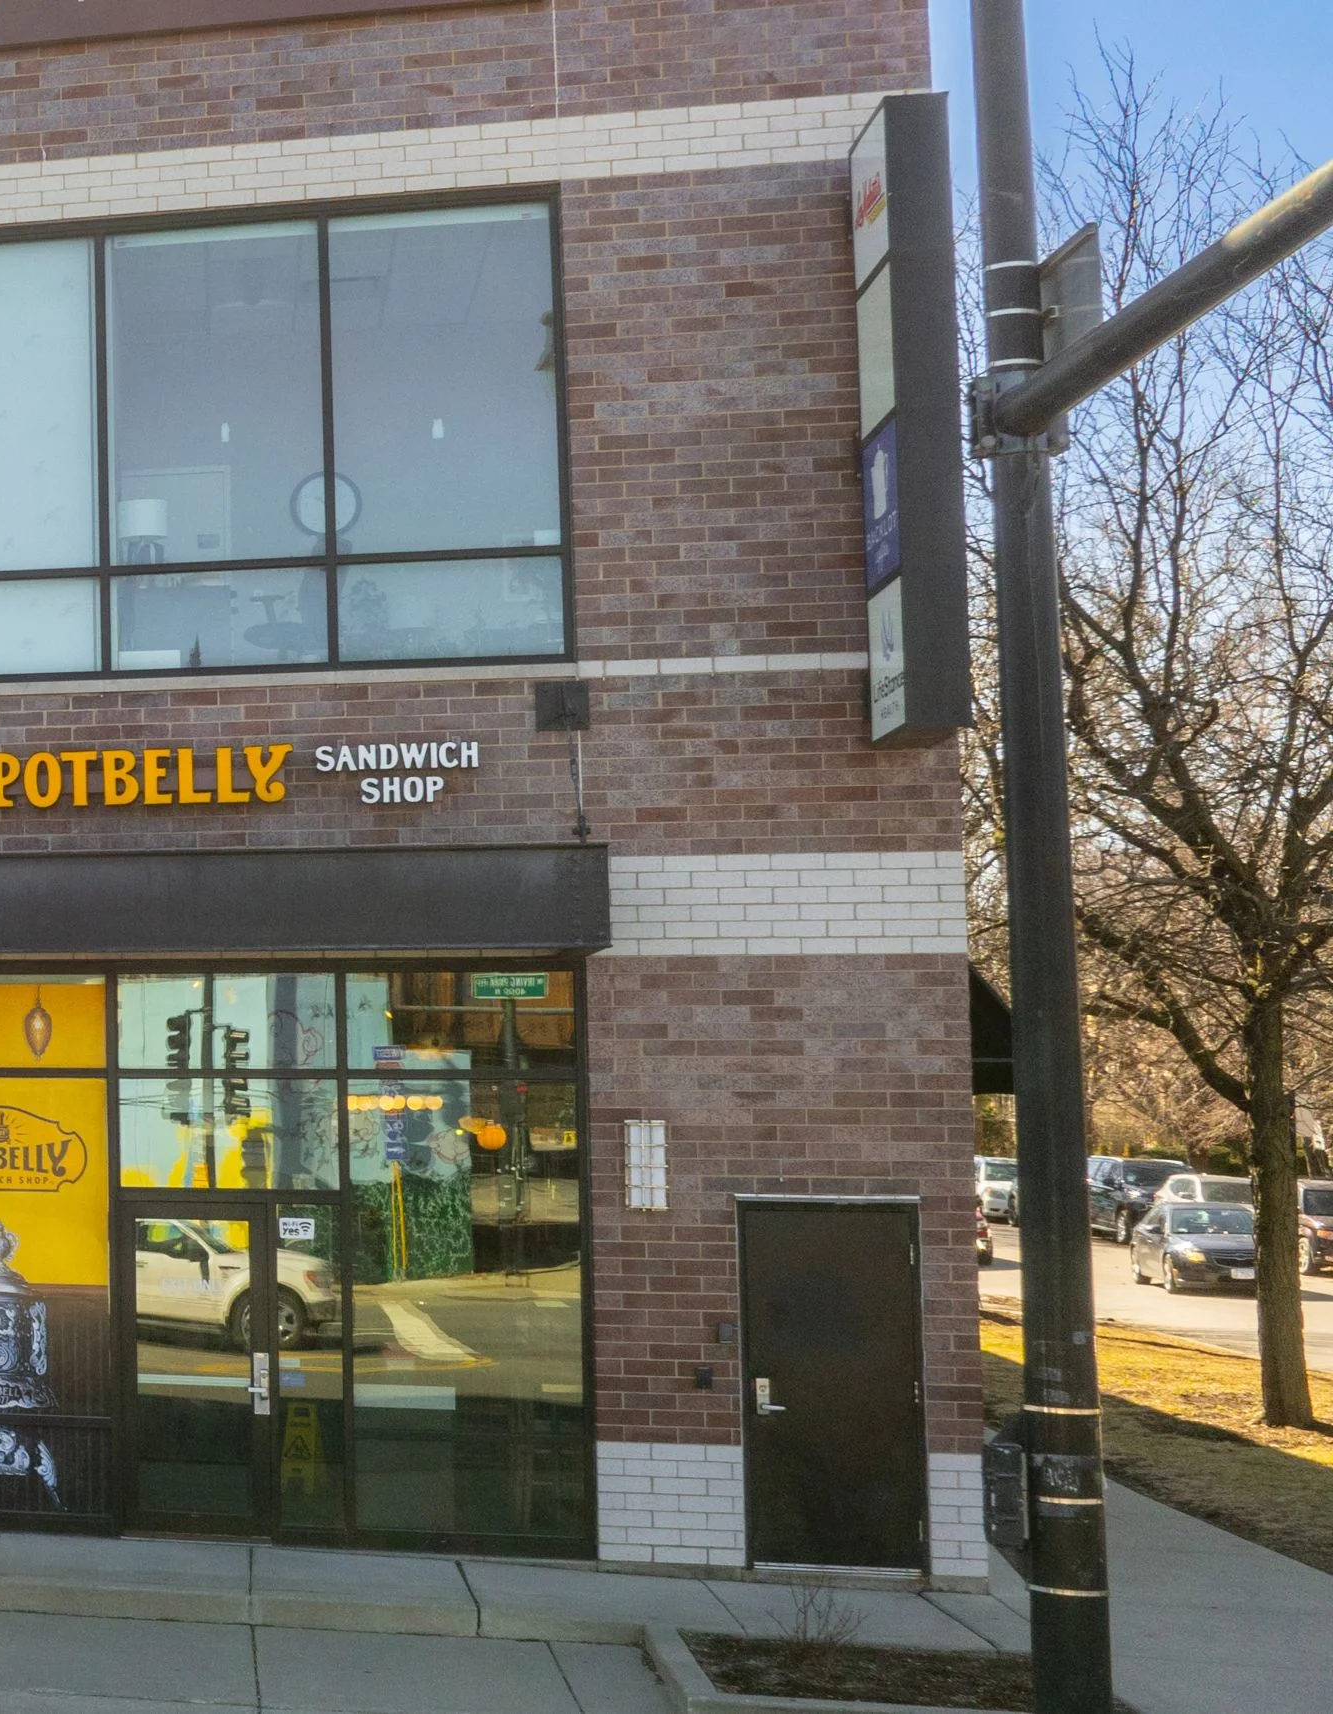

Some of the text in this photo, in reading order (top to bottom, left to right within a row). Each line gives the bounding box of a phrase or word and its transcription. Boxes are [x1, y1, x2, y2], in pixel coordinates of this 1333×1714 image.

[314, 740, 480, 772] SANDWICH
[360, 775, 445, 804] SHOP
[19, 1176, 50, 1186] SHOP
